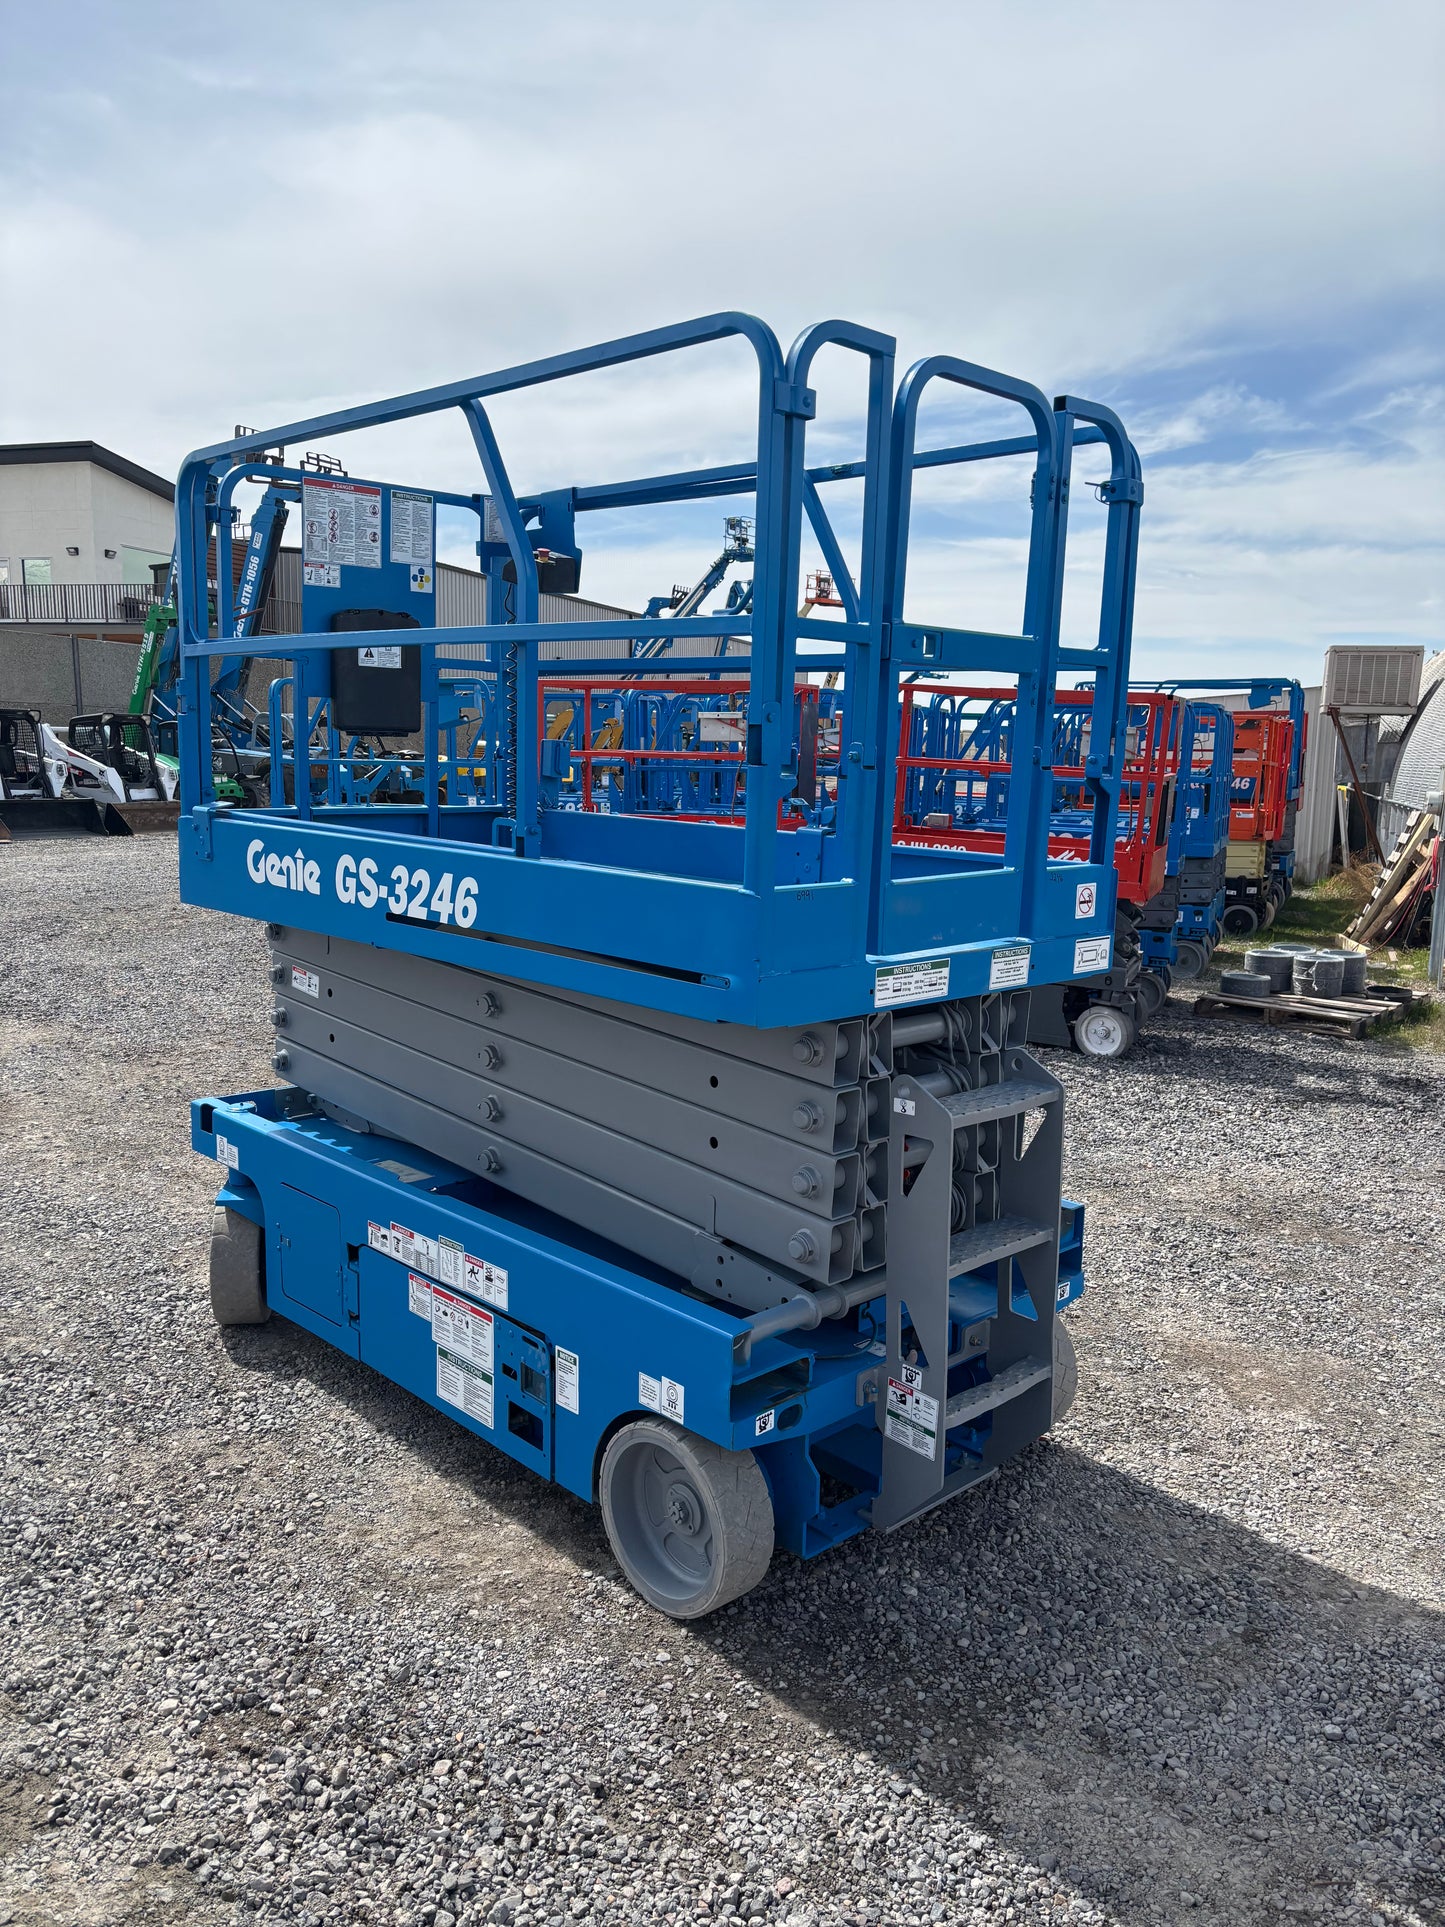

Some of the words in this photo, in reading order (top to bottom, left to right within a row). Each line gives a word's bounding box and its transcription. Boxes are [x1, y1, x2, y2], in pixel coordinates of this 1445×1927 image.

[240, 555, 260, 606] GTH-1056
[246, 838, 321, 896] Genie
[335, 854, 480, 928] GS-3246
[894, 962, 932, 974] INSTRUCTIONS
[447, 1353, 482, 1378] INSTRUCTIONS
